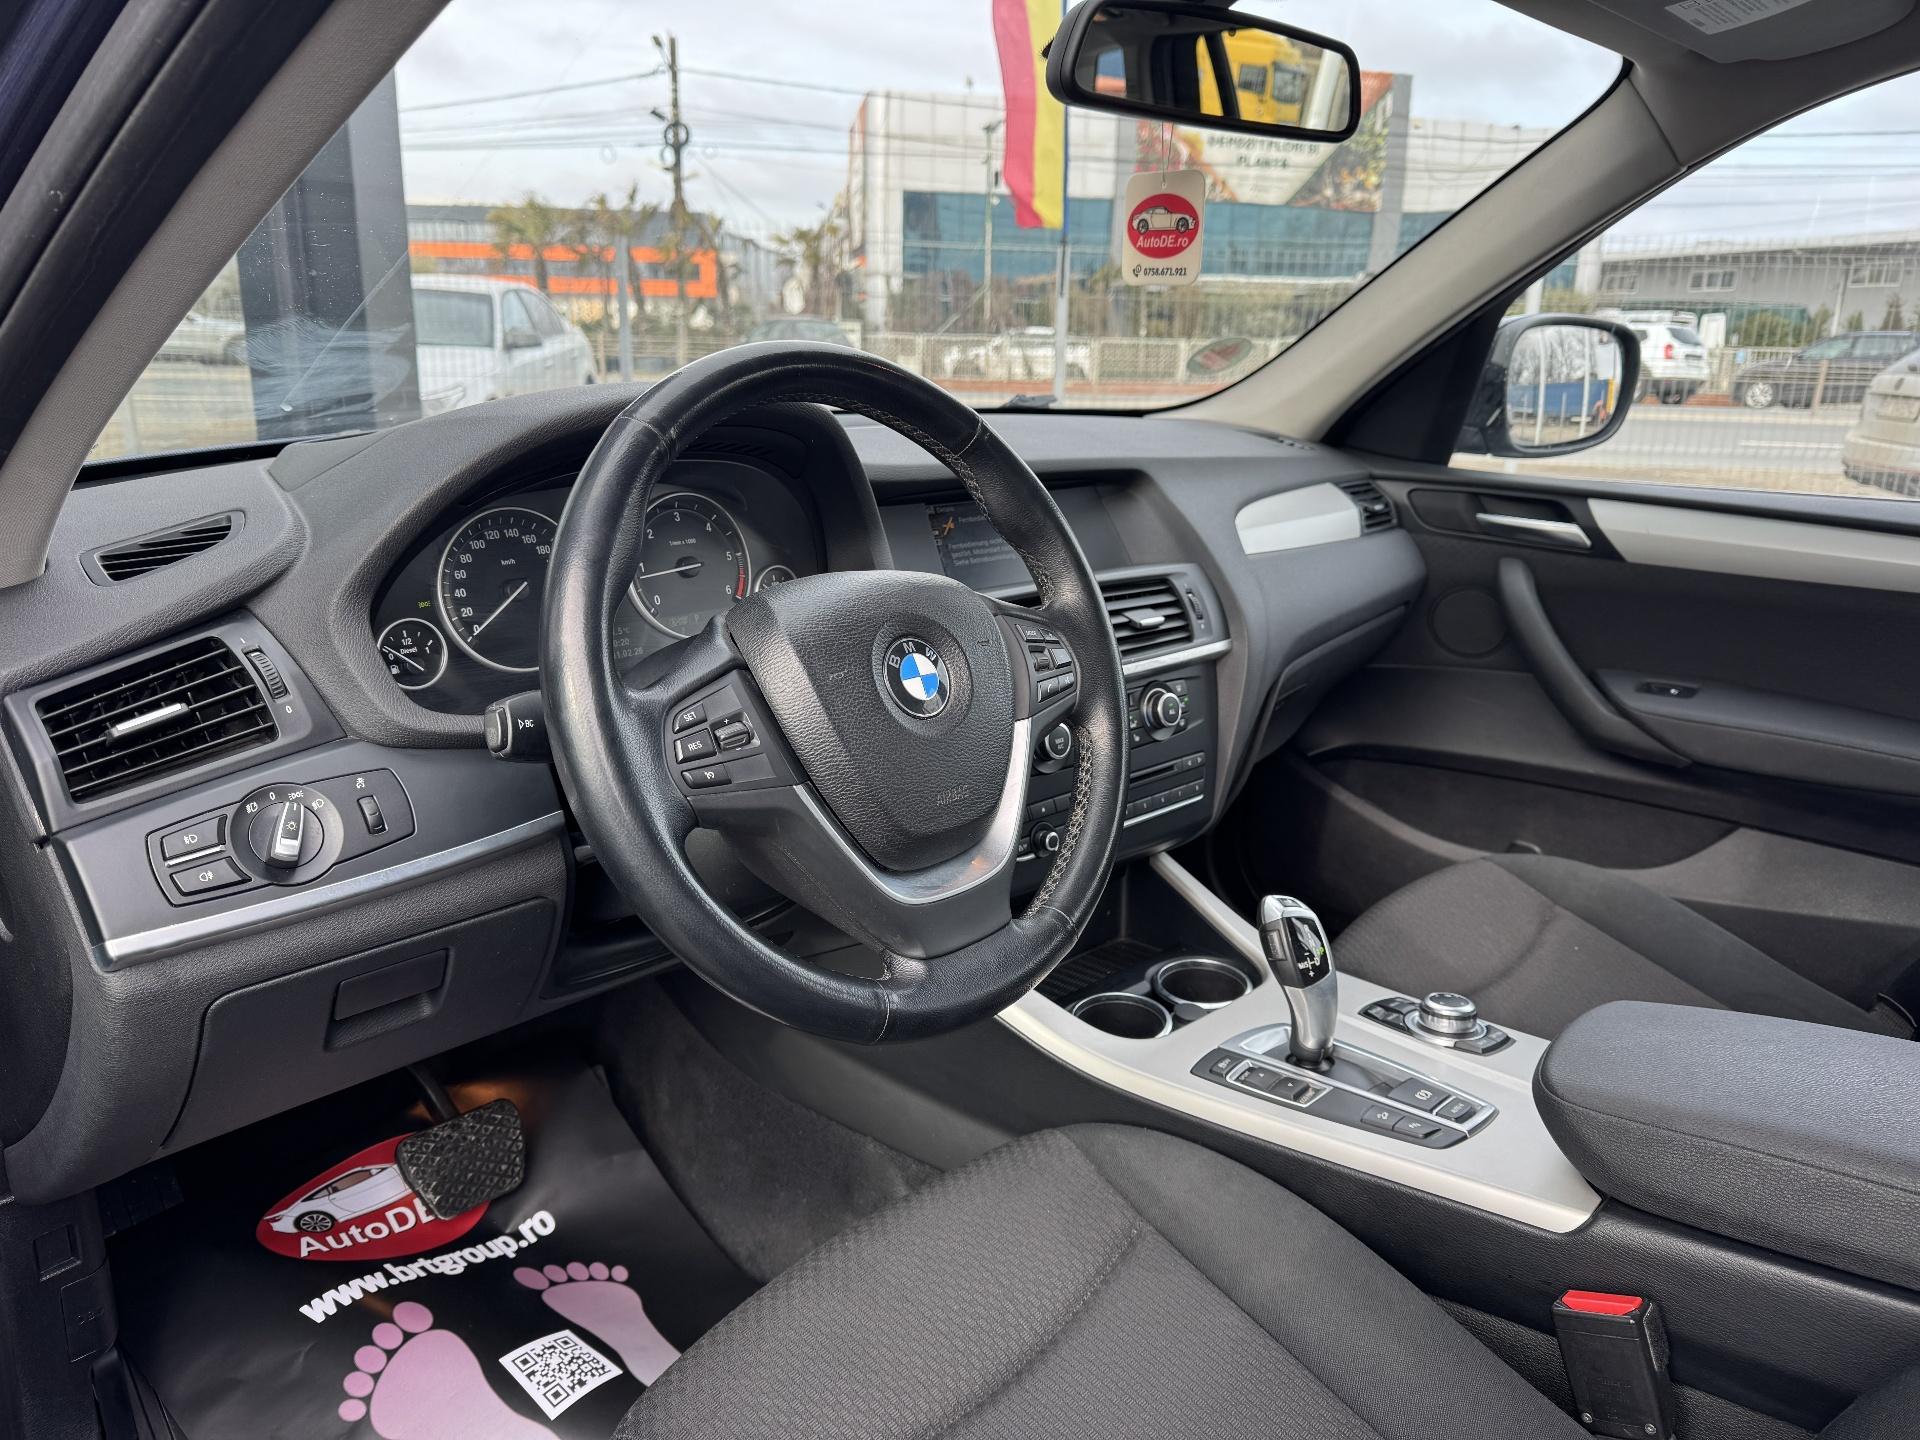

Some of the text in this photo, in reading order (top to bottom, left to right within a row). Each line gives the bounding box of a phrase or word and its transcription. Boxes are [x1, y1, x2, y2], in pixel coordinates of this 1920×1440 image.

[1136, 234, 1189, 248] AutoDE.ro
[674, 512, 681, 521] 3
[706, 522, 712, 532] 4
[484, 530, 500, 540] 120
[503, 528, 519, 538] 140
[646, 529, 654, 538] 2
[522, 534, 537, 544] 160
[469, 540, 486, 550] 100
[535, 545, 551, 555] 180
[460, 553, 473, 563] 80
[726, 551, 732, 561] 5
[501, 558, 516, 566] km/h
[639, 562, 645, 572] 1
[454, 569, 467, 579] 60
[454, 588, 467, 598] 40
[725, 585, 732, 594] 6
[654, 595, 661, 605] 0
[461, 607, 473, 617] 20
[401, 638, 413, 646] 1/2
[400, 646, 418, 655] Diesel
[889, 642, 937, 669] BMW
[388, 653, 394, 661] 0
[684, 712, 696, 722] SET
[688, 741, 702, 751] RES
[269, 792, 276, 801] 0
[299, 1210, 556, 1324] www.brtgroup.ro
